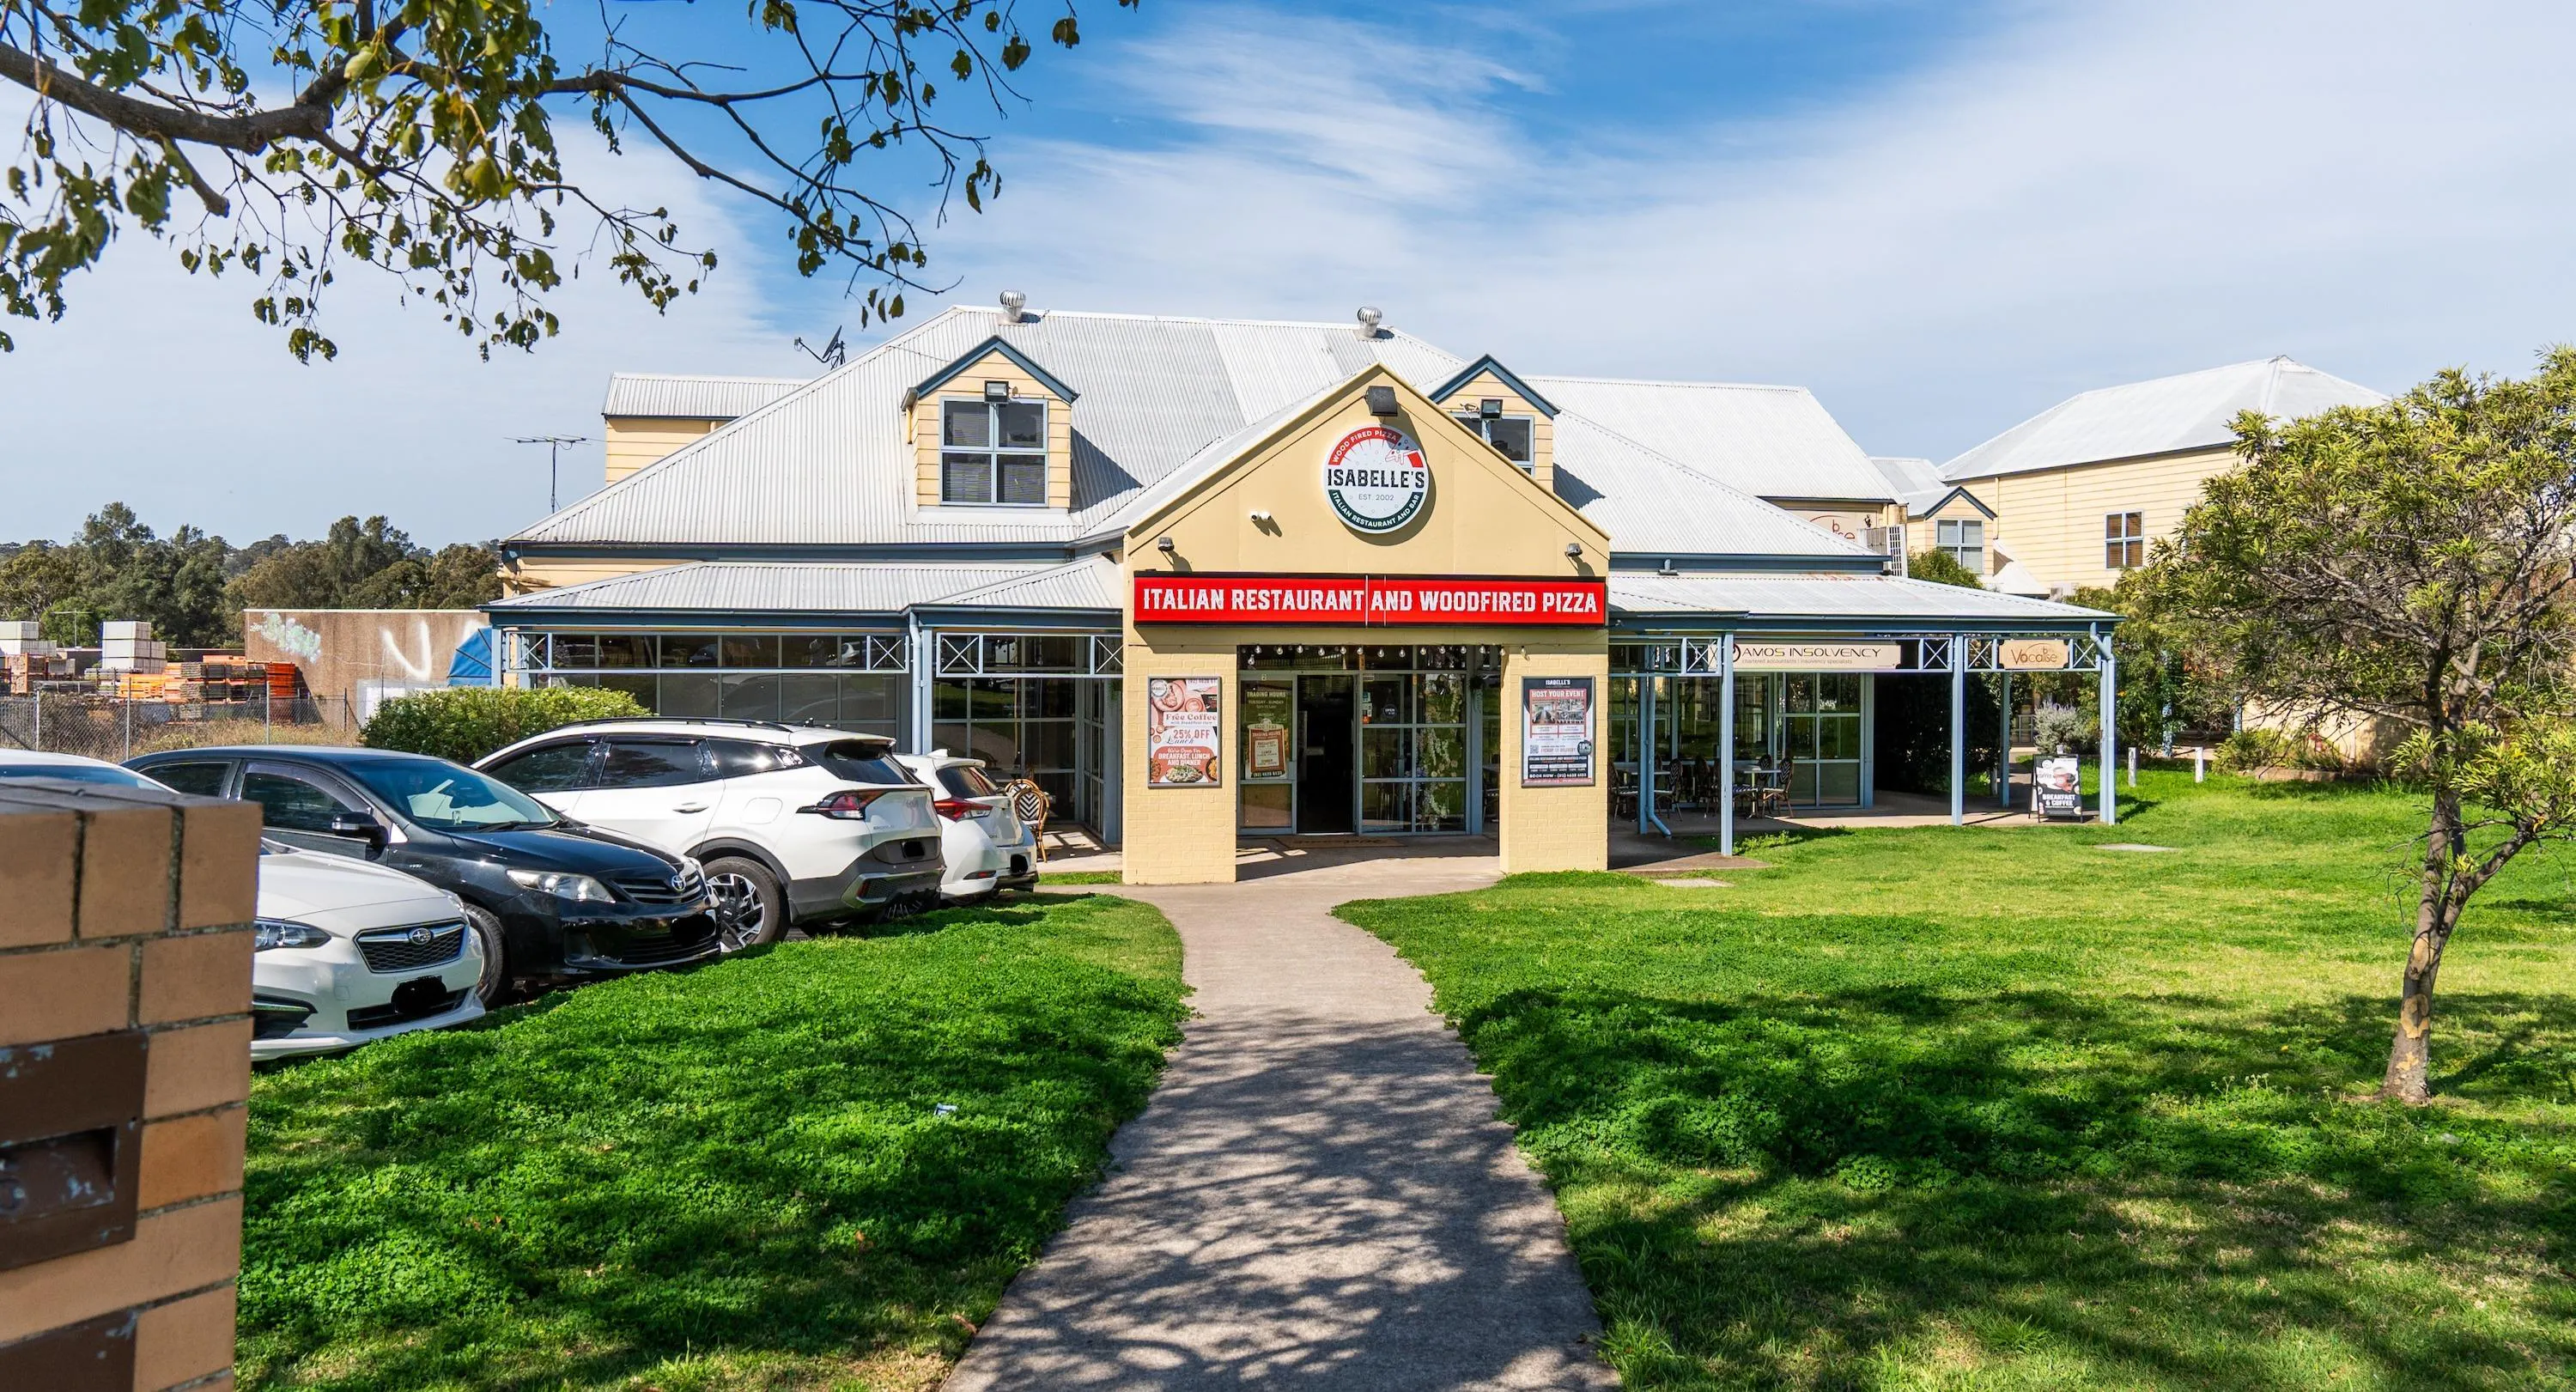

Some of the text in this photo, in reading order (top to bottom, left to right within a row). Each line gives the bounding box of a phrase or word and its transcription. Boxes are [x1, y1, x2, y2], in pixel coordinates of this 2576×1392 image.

[1332, 430, 1398, 463] WOOD FIRED PIZZA
[1327, 469, 1425, 489] ISABELLE'S
[1332, 492, 1420, 527] ITALIAN RESTAURANT AND BAR
[1143, 588, 1598, 613] ITALIAN RESTAURANT AND WOODFIRED PIZZA
[1741, 647, 1881, 658] AMOS INSOLVENCY
[1173, 729, 1210, 739] 25% OFF
